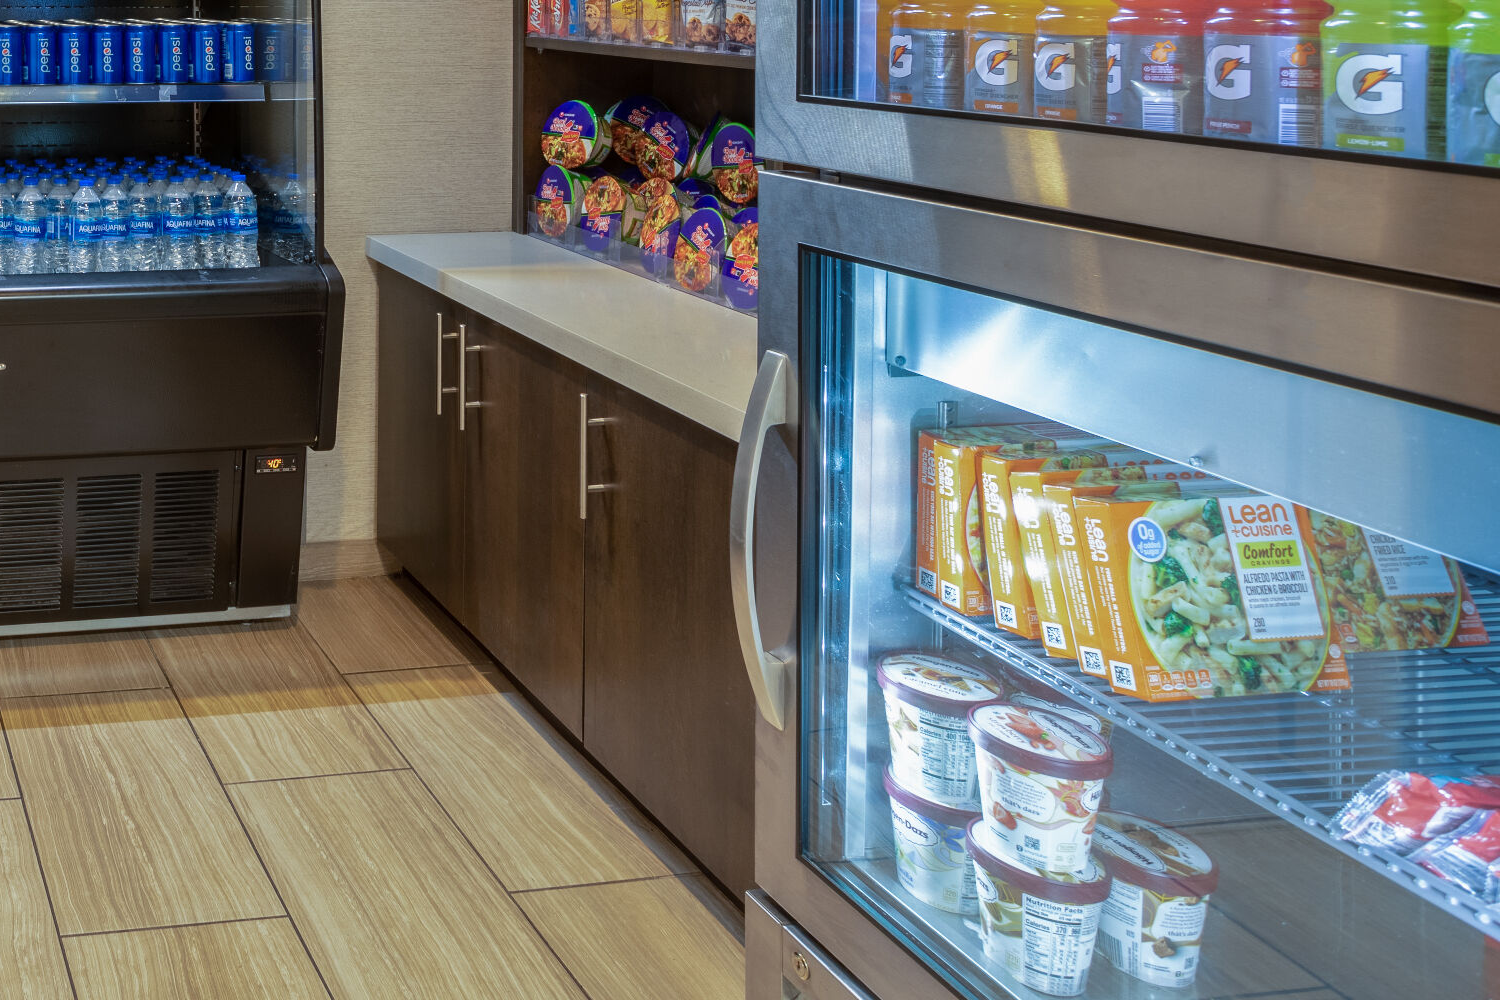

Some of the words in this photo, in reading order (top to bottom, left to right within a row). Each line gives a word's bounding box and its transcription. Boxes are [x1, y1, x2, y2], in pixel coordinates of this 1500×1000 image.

[1, 38, 13, 74] pepsi
[41, 38, 51, 73] pepsi
[70, 38, 82, 73] pepsi
[102, 37, 114, 73] pepsi
[132, 37, 144, 72] pepsi
[172, 37, 183, 71] pepsi
[205, 36, 216, 71] pepsi
[243, 36, 254, 71] pepsi
[975, 39, 1018, 86] G
[1035, 42, 1076, 91] G
[1335, 54, 1403, 115] G
[1228, 503, 1289, 524] Lean
[1241, 523, 1293, 538] CUISINE
[1091, 518, 1109, 562] Lean
[1137, 522, 1156, 540] 0g
[1243, 542, 1293, 560] Comfort
[1250, 558, 1291, 567] CRAVINGS
[1373, 545, 1392, 555] FRIED
[1243, 572, 1271, 584] ALFREDO
[1271, 571, 1289, 582] PASTA
[1290, 570, 1305, 581] WITH
[1246, 584, 1273, 596] CHICKEN
[1279, 582, 1308, 594] BROCCOLI
[1026, 895, 1063, 913] Nutrition
[1025, 918, 1050, 932] Calories
